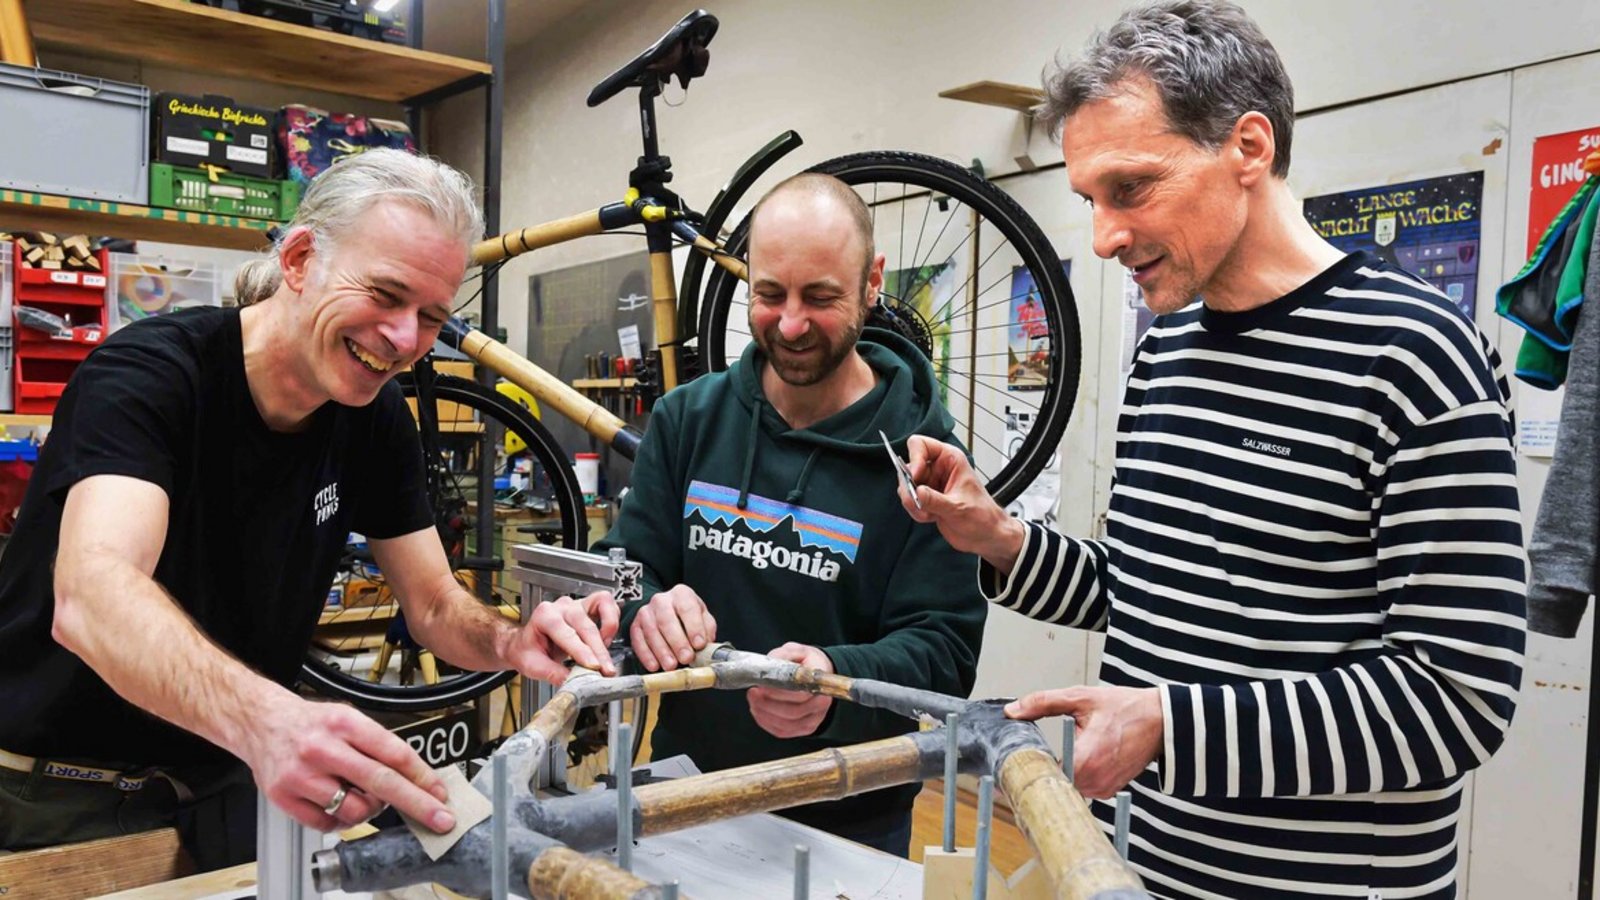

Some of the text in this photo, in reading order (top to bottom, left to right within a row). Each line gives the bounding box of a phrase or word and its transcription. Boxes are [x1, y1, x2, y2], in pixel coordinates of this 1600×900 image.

[1540, 158, 1592, 188] GING
[1358, 191, 1416, 213] LANGE
[1242, 437, 1291, 456] SALZWASSER
[688, 524, 841, 582] patagonia
